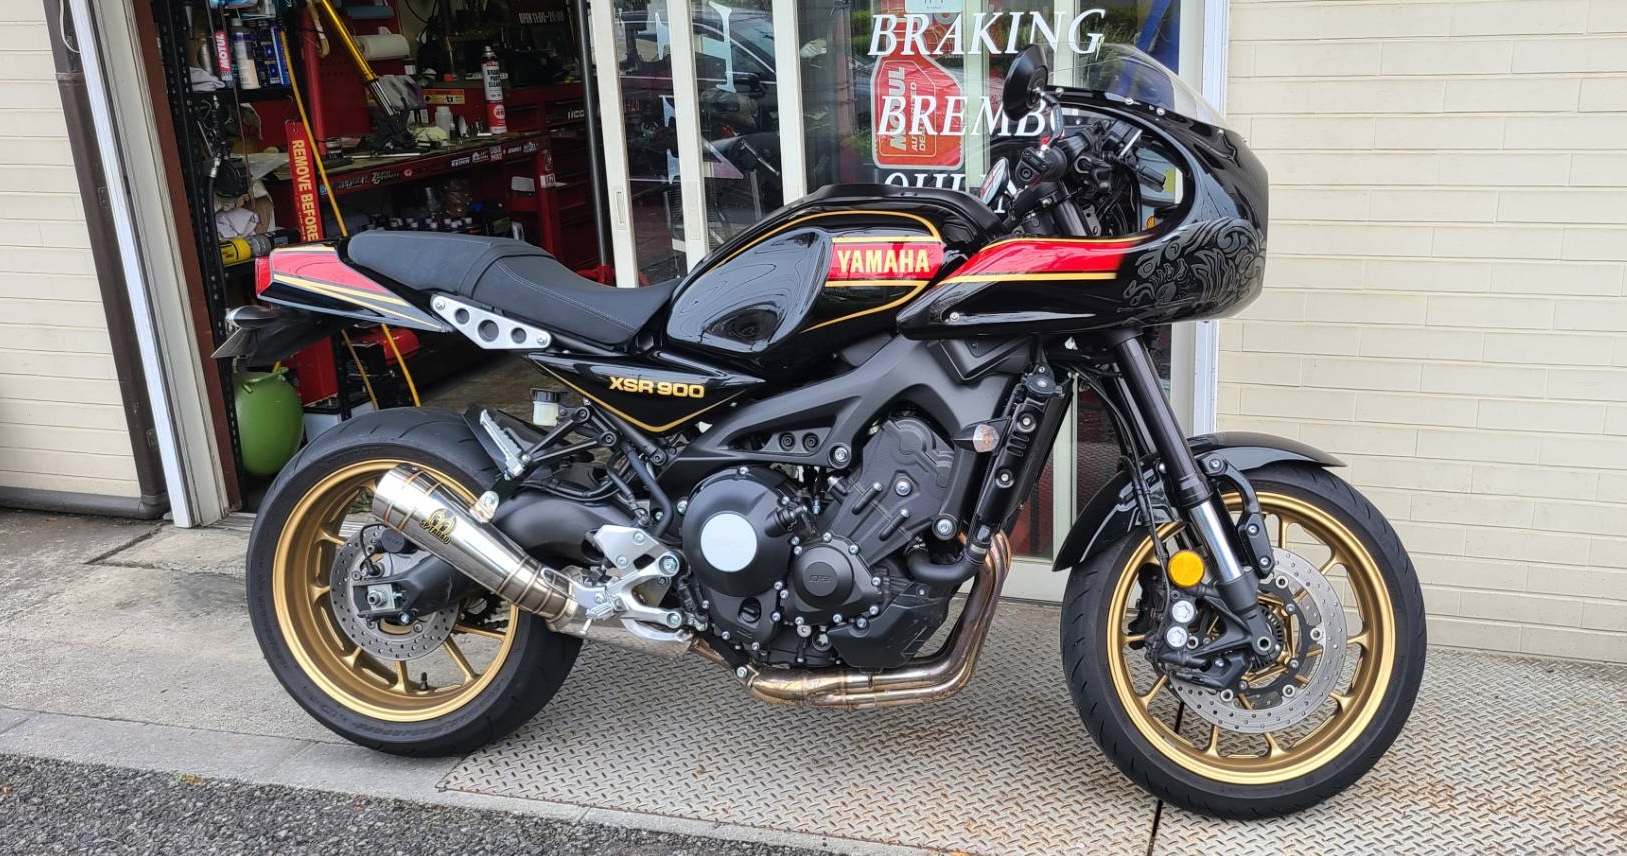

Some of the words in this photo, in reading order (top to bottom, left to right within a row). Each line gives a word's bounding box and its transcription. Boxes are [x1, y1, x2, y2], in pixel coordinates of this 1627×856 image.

[215, 33, 231, 69] MOTUL
[867, 9, 1106, 56] BRAKING
[291, 139, 312, 191] REMOVE
[300, 193, 319, 242] BEFORE
[837, 249, 931, 273] YAMAHA
[609, 376, 654, 394] XSR
[657, 382, 705, 399] 900
